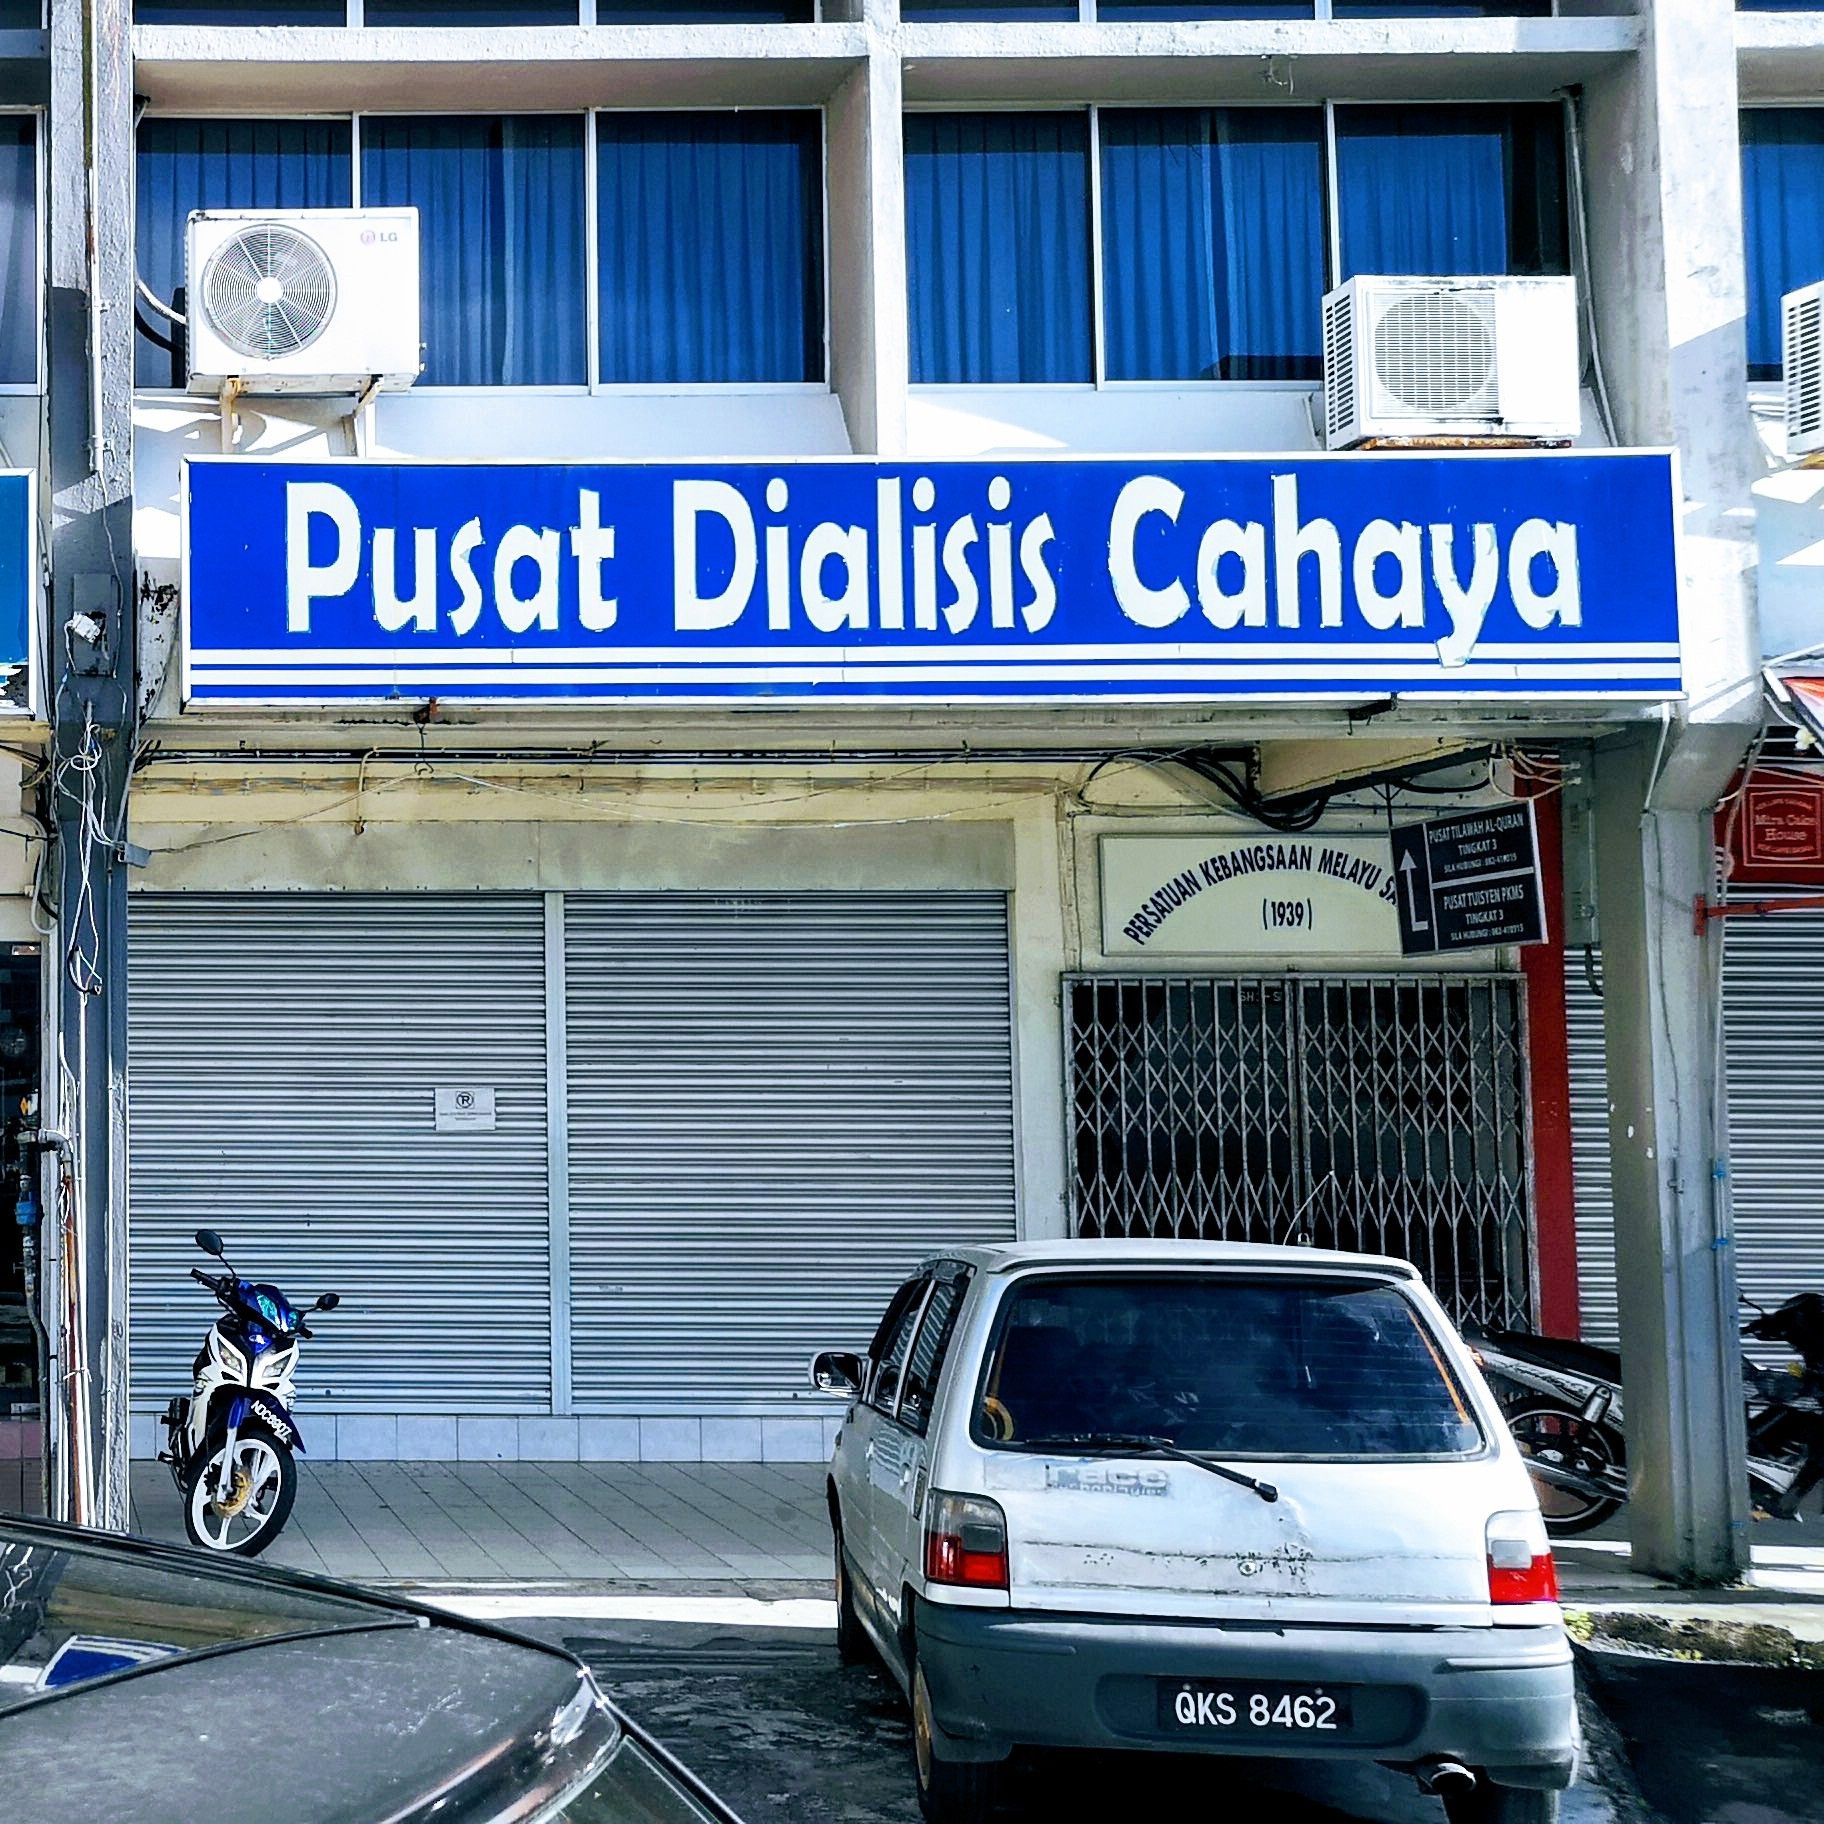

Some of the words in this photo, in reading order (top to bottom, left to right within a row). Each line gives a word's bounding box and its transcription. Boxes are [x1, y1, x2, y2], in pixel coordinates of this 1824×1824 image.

[380, 233, 398, 243] LG
[285, 482, 618, 636] Pusat
[672, 477, 1058, 635] Dialisis
[1107, 473, 1582, 668] Cahaya
[1428, 826, 1450, 843] PUSAT
[1451, 820, 1484, 840] TILAWAH
[1485, 812, 1525, 833] AL-QURAN
[1764, 828, 1809, 841] House
[1457, 840, 1491, 856] TINGKAT
[1491, 838, 1498, 850] 3
[1122, 868, 1203, 946] PERSATUAN
[1198, 844, 1313, 887] KEBANGSAAN
[1317, 847, 1383, 890] MELAYU
[1443, 892, 1467, 910] PUSAT
[1467, 887, 1501, 907] TUISYEN
[1501, 883, 1525, 902] PKMS
[1262, 897, 1313, 931] (1939)
[1464, 909, 1498, 925] TINGKAT
[1498, 908, 1504, 920] 3
[1175, 1691, 1238, 1726] QKS
[1248, 1693, 1338, 1730] 8462
